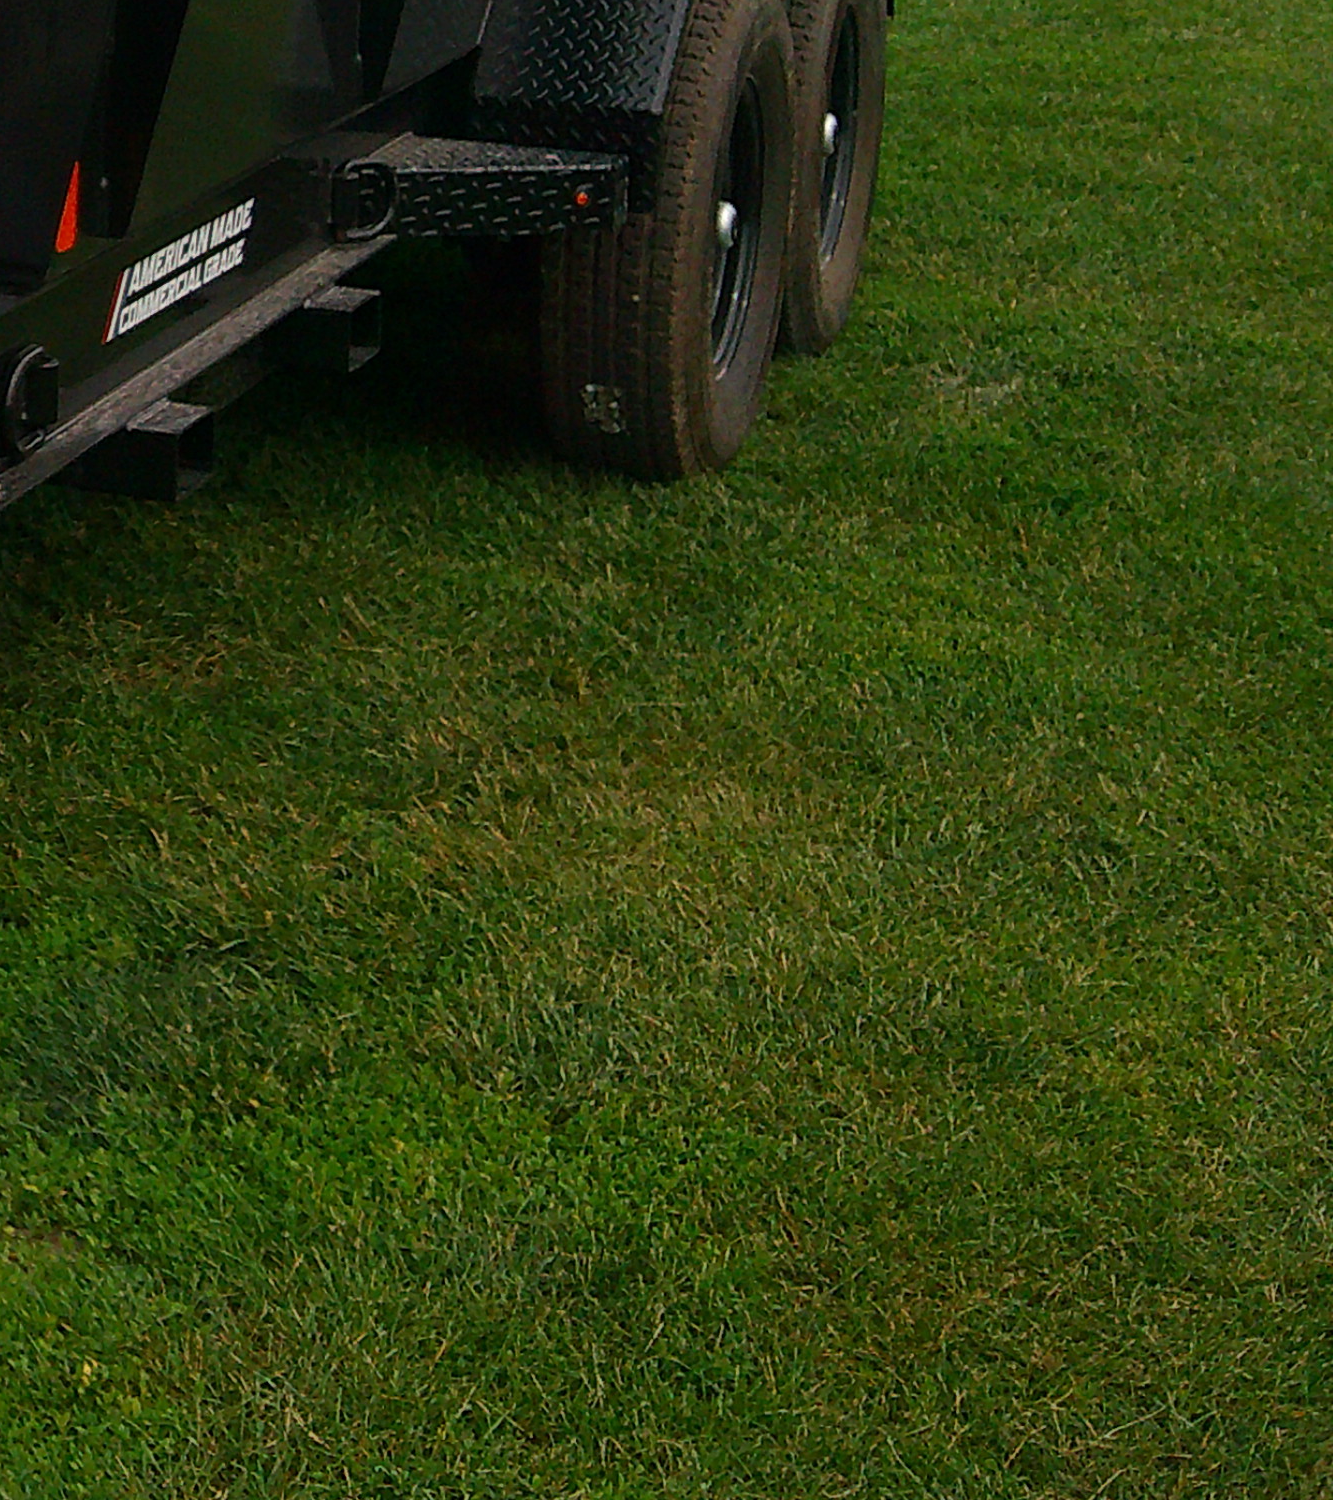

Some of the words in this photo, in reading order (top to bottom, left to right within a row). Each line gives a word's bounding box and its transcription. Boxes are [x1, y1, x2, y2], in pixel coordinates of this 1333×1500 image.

[117, 262, 204, 336] COMMERCIAL
[203, 237, 247, 285] GRADE
[127, 221, 212, 297] AMERICAN
[209, 198, 255, 250] MADE
